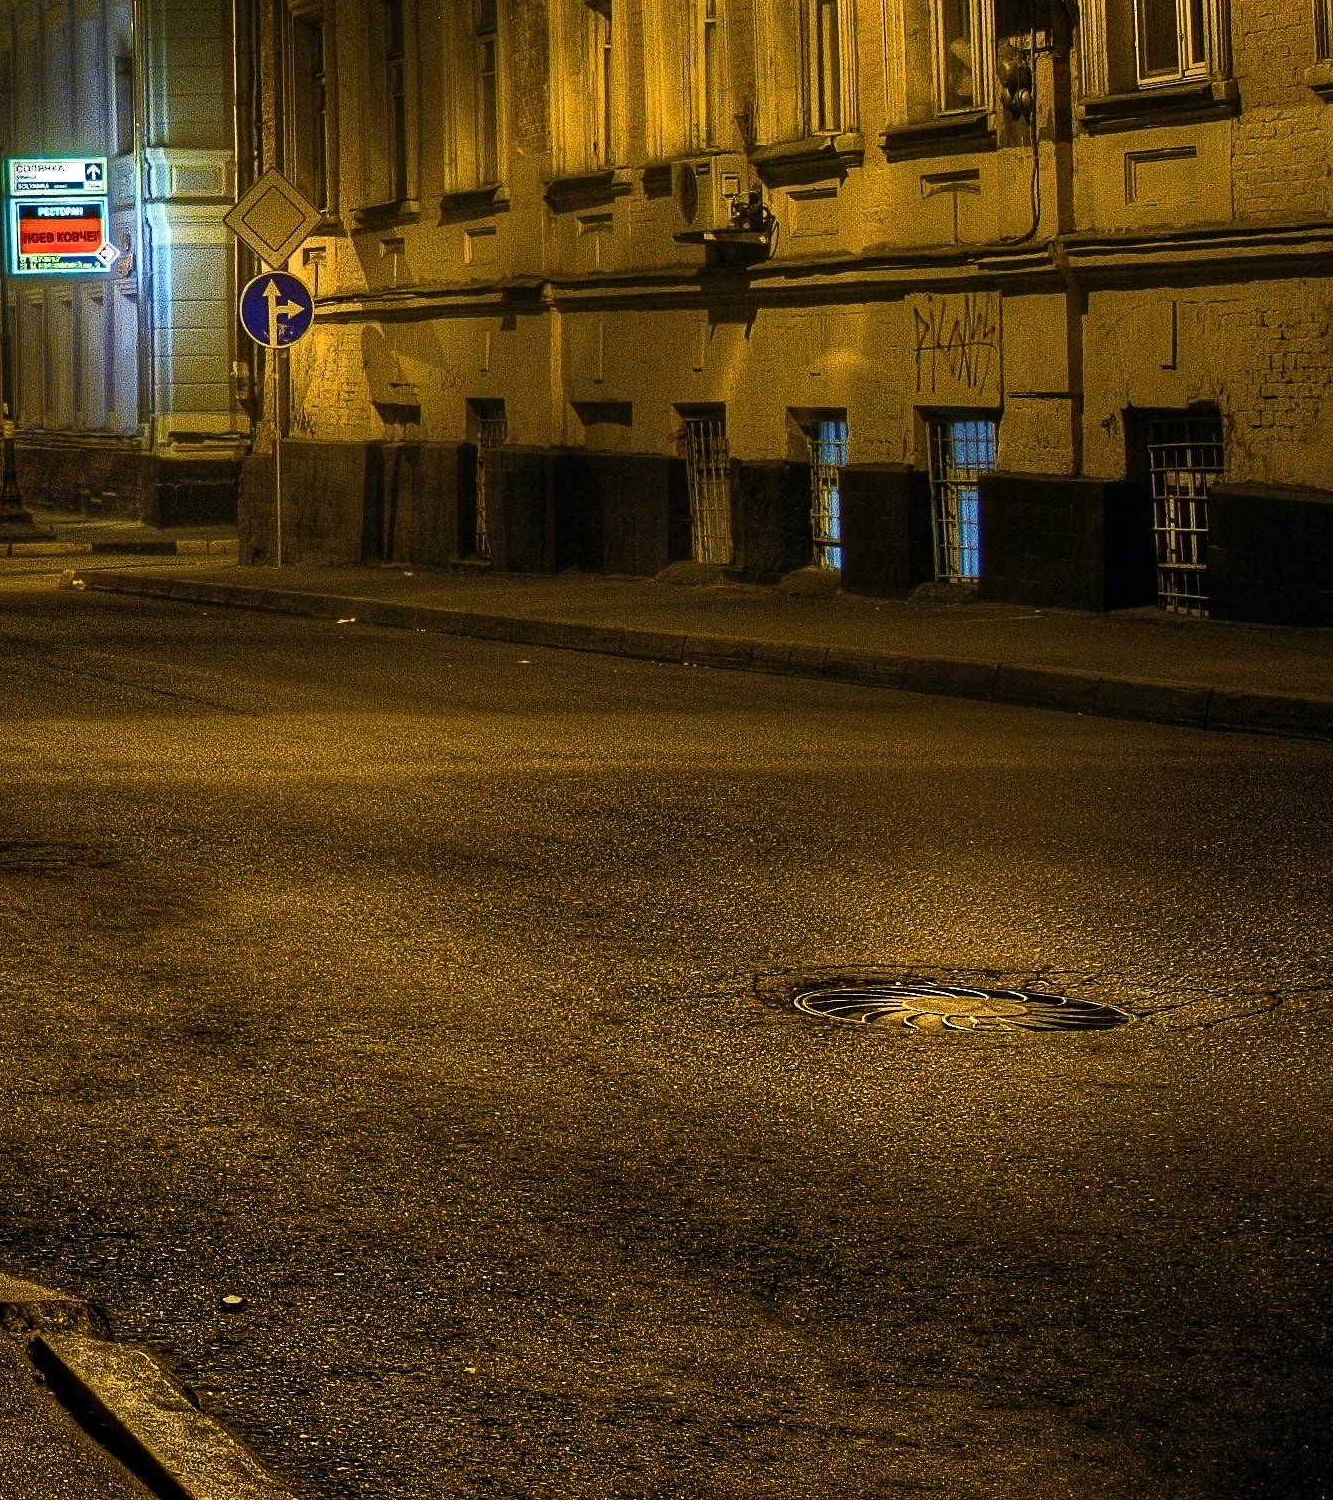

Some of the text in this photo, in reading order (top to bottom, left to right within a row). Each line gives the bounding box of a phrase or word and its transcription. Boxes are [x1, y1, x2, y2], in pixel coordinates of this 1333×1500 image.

[16, 164, 65, 173] СОЛЯНКА
[37, 206, 83, 217] РЕСТОРАН
[22, 230, 100, 244] НОЕВ КОВЧЕГ
